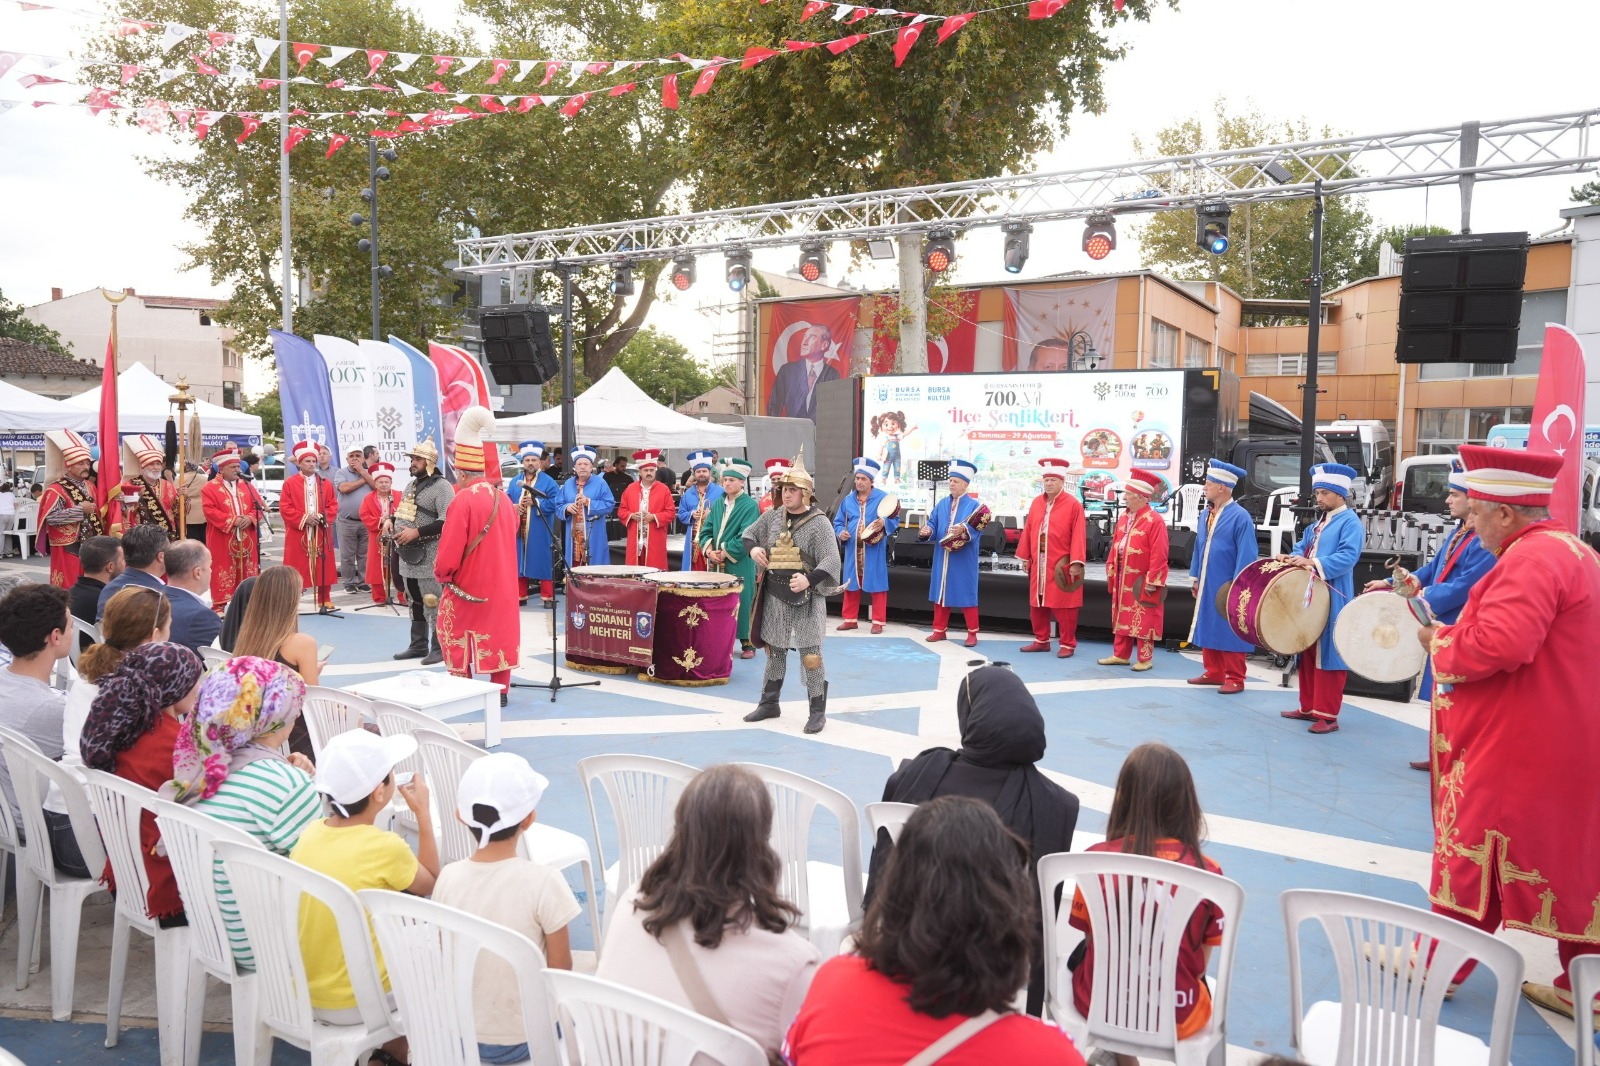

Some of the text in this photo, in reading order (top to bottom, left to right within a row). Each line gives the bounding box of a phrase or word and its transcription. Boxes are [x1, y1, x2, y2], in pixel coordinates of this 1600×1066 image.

[1145, 386, 1169, 397] 700
[985, 391, 1020, 407] 700.
[947, 406, 1080, 430] İlçe Şenlikleri
[1022, 432, 1052, 440] Ağustos
[589, 613, 632, 627] OSMANLI
[589, 626, 631, 640] MEHTERİ
